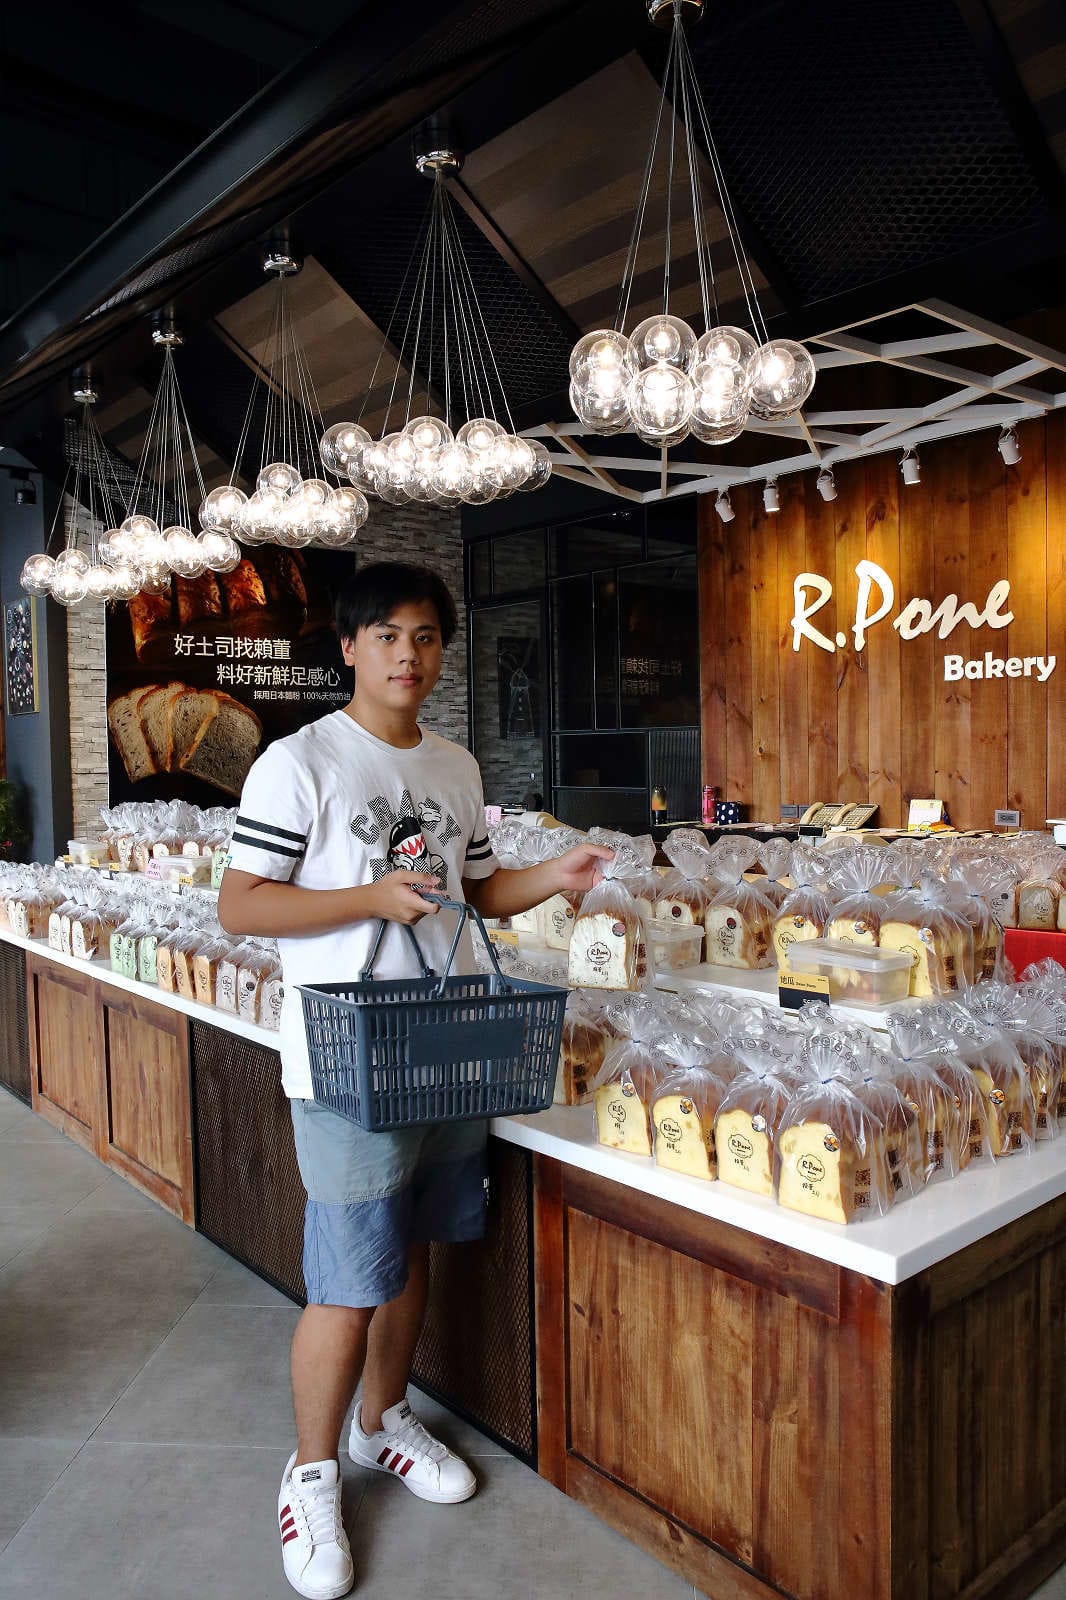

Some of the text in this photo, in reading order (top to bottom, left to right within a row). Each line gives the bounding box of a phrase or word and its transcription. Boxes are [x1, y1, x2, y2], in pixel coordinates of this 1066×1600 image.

[790, 559, 1015, 653] R.Pone
[173, 633, 292, 660] 好土司找賴董
[216, 663, 341, 687] 料好新鮮足感心
[943, 651, 1057, 682] Bakery
